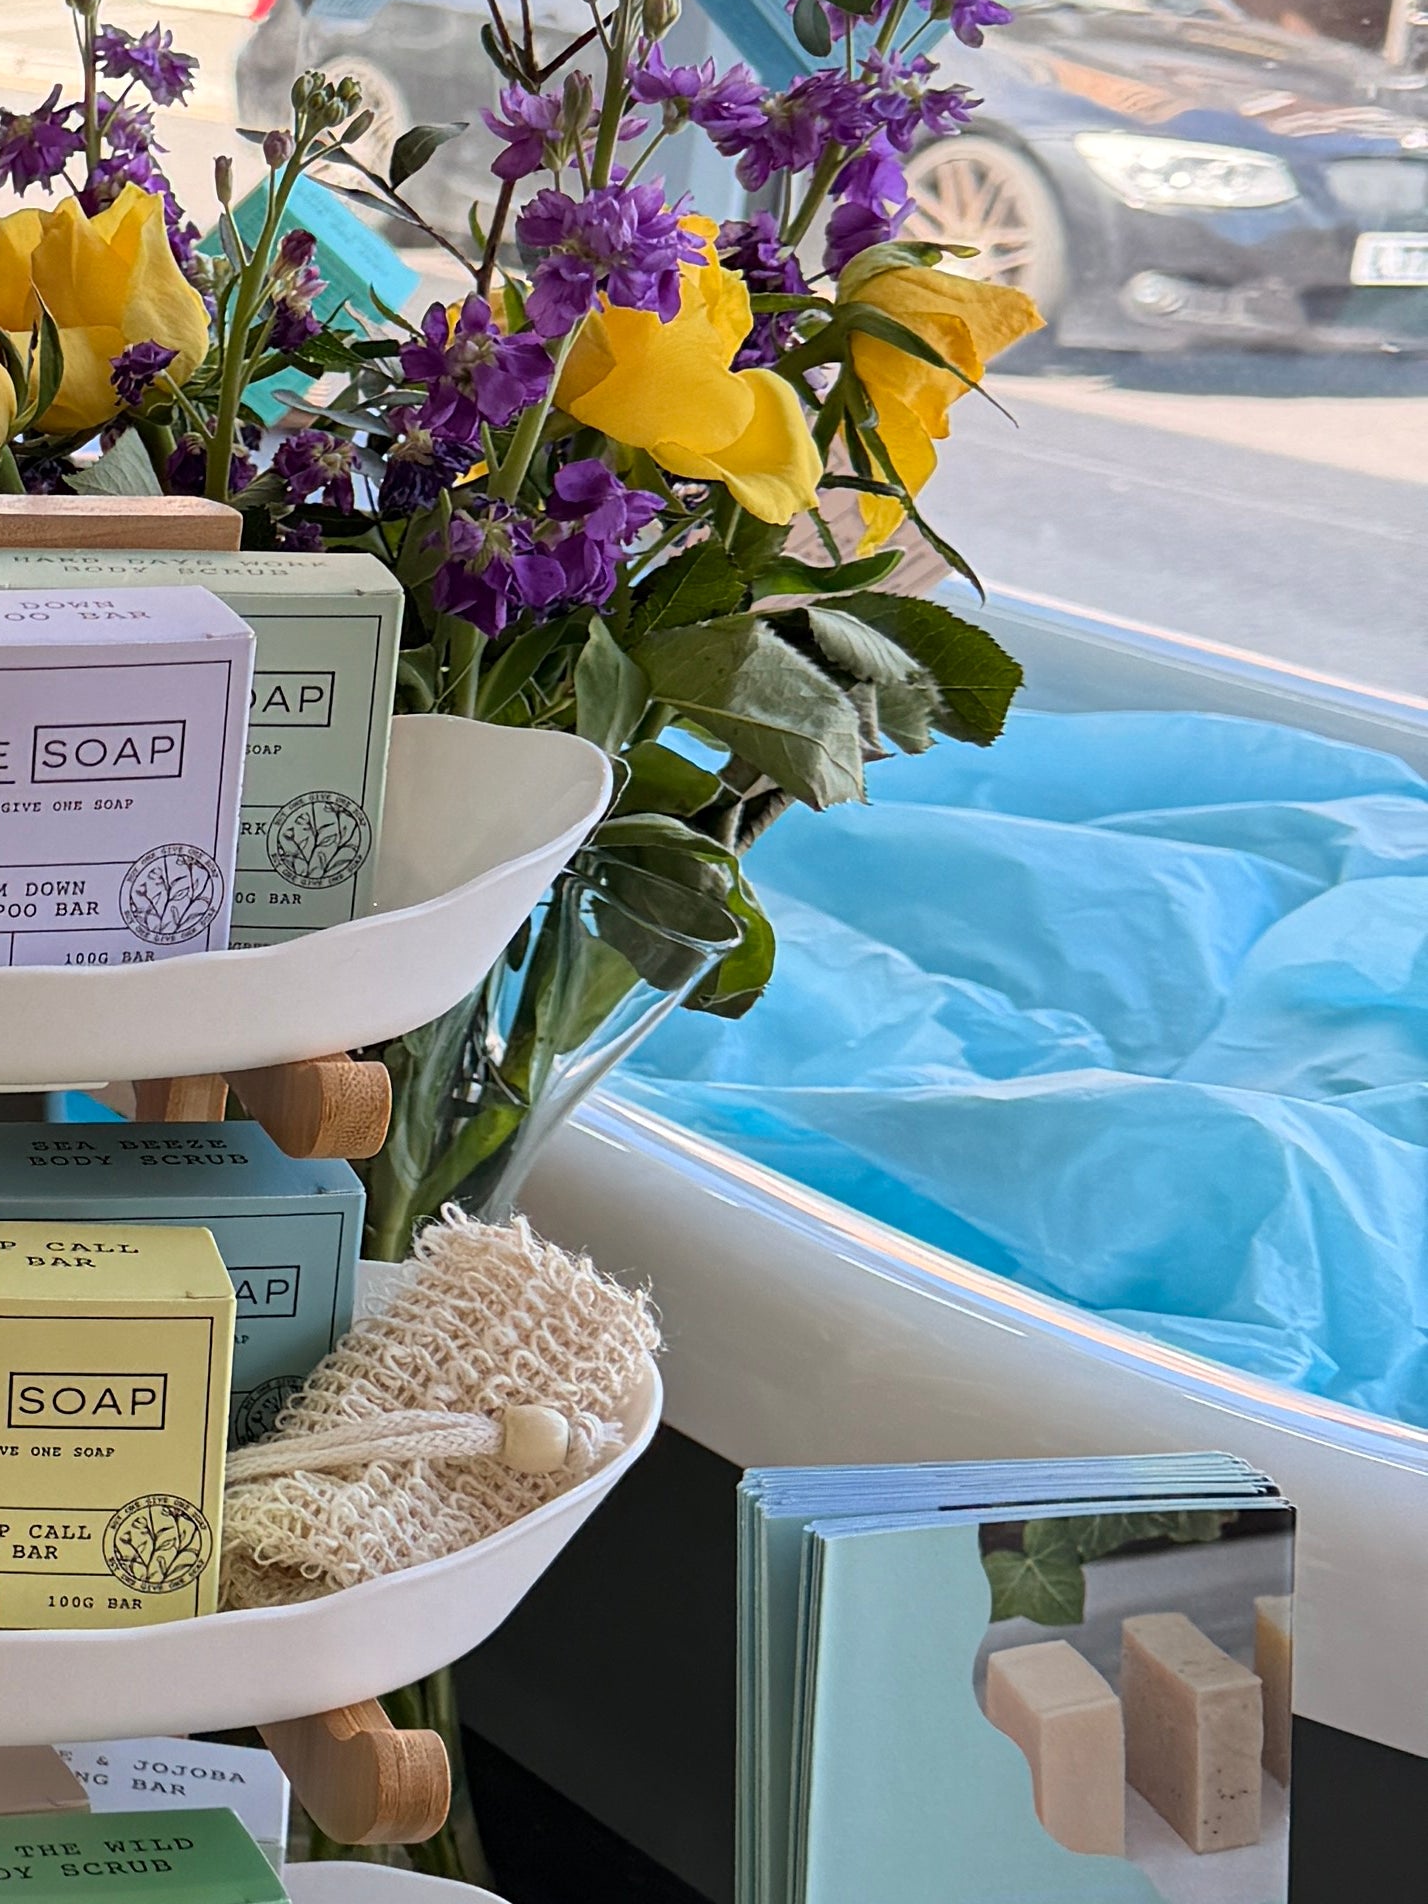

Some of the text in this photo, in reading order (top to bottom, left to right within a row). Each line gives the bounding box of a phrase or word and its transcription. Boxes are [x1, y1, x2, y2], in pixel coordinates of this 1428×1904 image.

[21, 600, 116, 610] DOWN
[78, 610, 152, 621] BAR
[42, 736, 175, 769] SOAP
[1, 801, 42, 813] GIVE
[52, 800, 84, 812] ONE
[94, 798, 134, 810] SOAP
[25, 881, 86, 897] DOWN
[55, 901, 100, 916] BAR
[31, 1139, 228, 1151] SEA BEEZE
[30, 1154, 249, 1167] BODY SCRUB
[45, 1242, 140, 1254] CALL
[26, 1256, 98, 1269] BAR
[18, 1386, 157, 1416] SOAP
[30, 1446, 62, 1458] ONE
[73, 1447, 115, 1458] SOAP
[29, 1524, 92, 1540] CALL
[12, 1544, 59, 1560] BAR
[48, 1596, 143, 1610] 100G BAR
[133, 1760, 246, 1784] JOJOBA
[132, 1778, 187, 1796] BAR
[15, 1843, 81, 1859] THE
[104, 1837, 195, 1854] WILD
[61, 1859, 173, 1877] SCRUB
